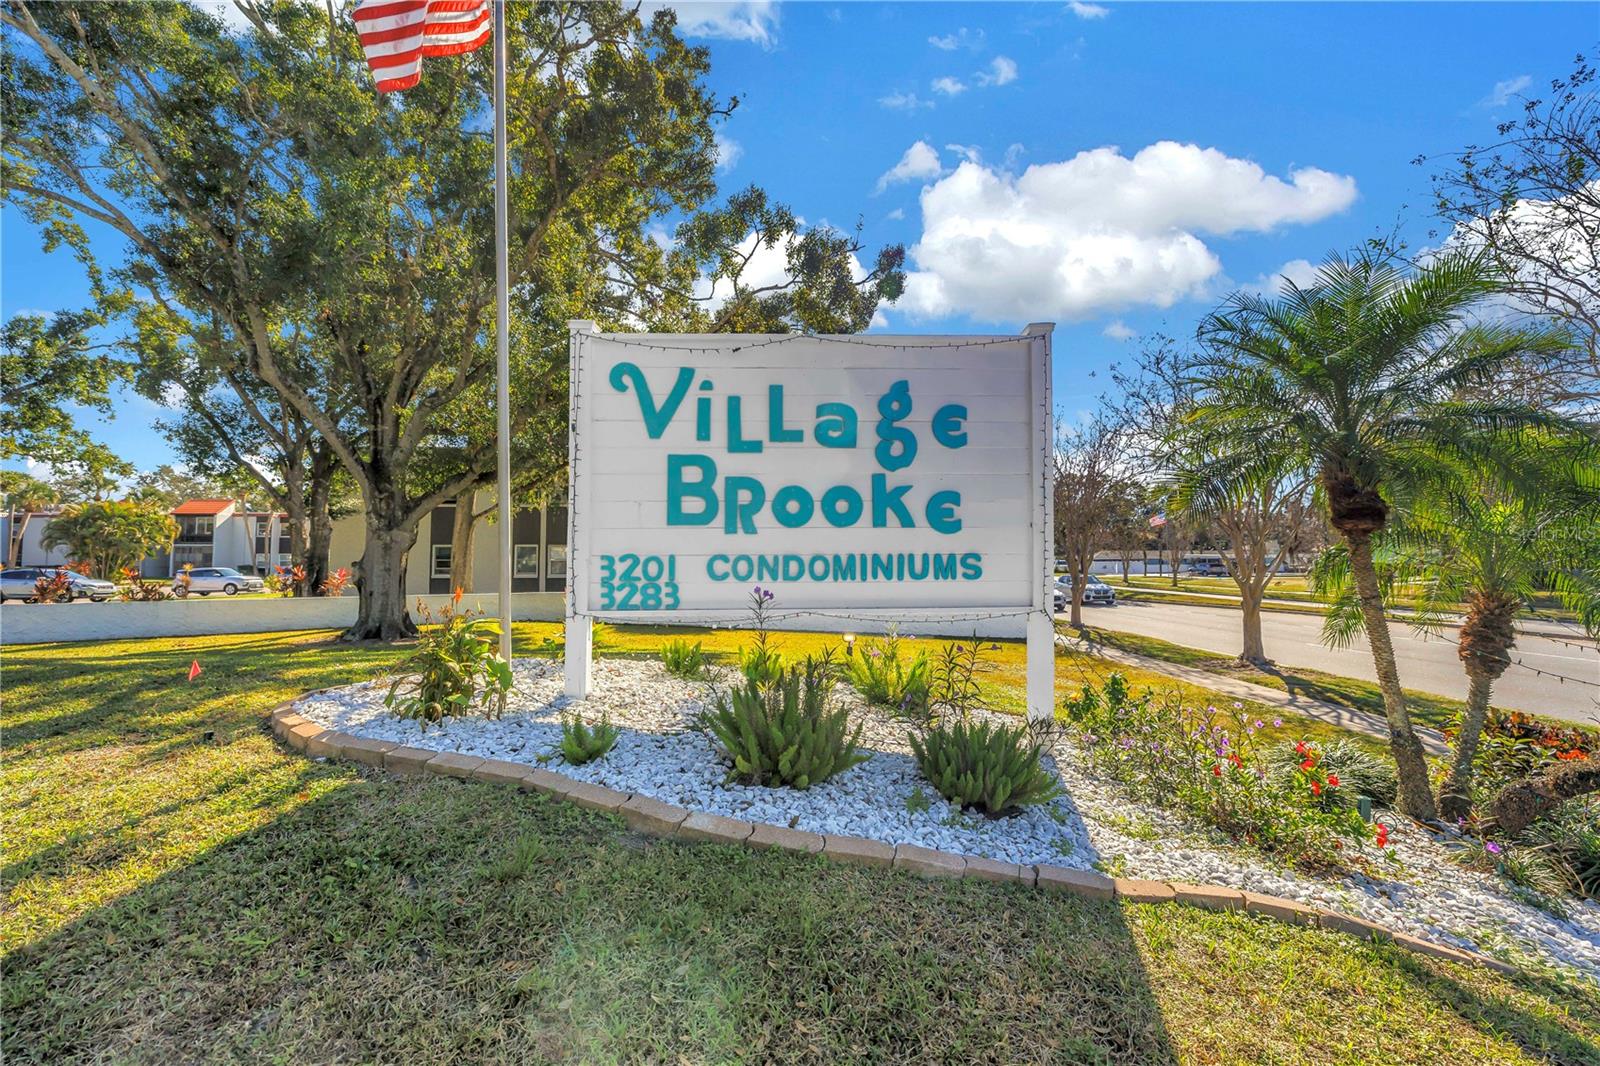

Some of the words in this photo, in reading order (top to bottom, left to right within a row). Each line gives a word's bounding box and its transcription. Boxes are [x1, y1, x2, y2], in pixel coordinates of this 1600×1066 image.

[600, 553, 676, 583] 3201
[706, 553, 983, 582] CONDOMINIUMS
[600, 581, 681, 610] 3283
